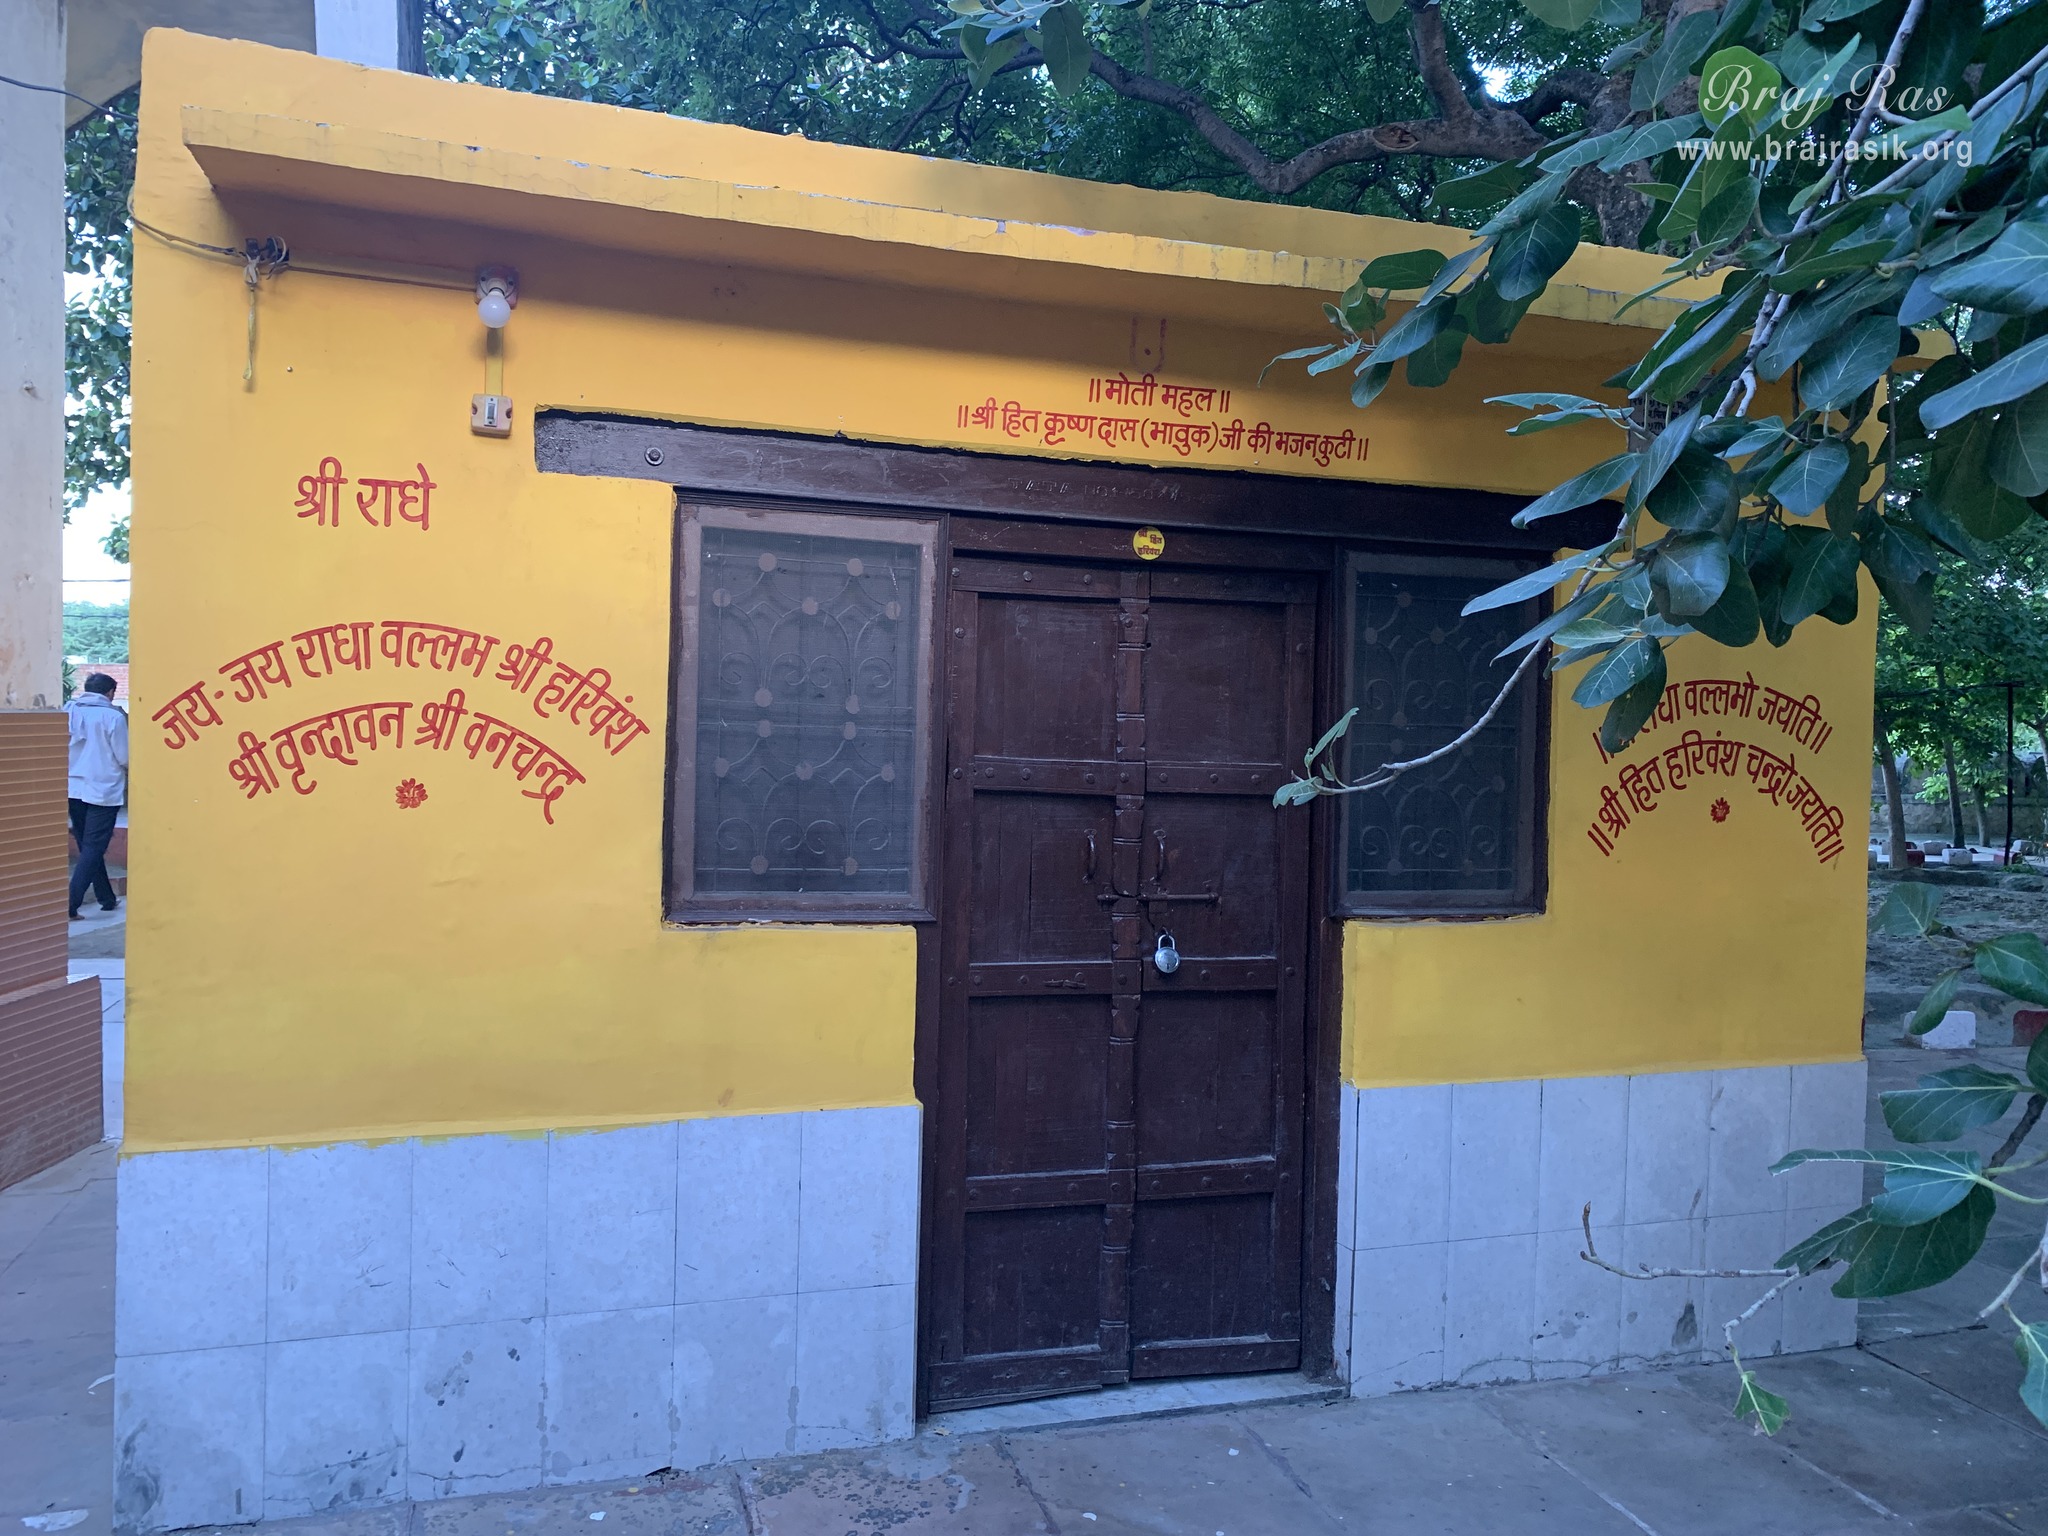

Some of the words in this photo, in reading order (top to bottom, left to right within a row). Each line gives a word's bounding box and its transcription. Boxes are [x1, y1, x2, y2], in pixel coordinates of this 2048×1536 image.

[1001, 400, 1043, 438] हित
[1044, 411, 1098, 446] कृष्ण
[1097, 416, 1141, 448] दास
[294, 457, 348, 527] श्री
[357, 463, 437, 530] राधे
[291, 622, 375, 678] राधा
[380, 620, 501, 677] वल्लभ
[495, 636, 554, 693] श्री
[533, 662, 650, 756] हरिवंश
[228, 731, 280, 799] श्री
[270, 702, 413, 795] वृन्दावन
[415, 688, 468, 750] श्री
[1618, 756, 1667, 814] हित
[1662, 730, 1746, 791] हरिवंश
